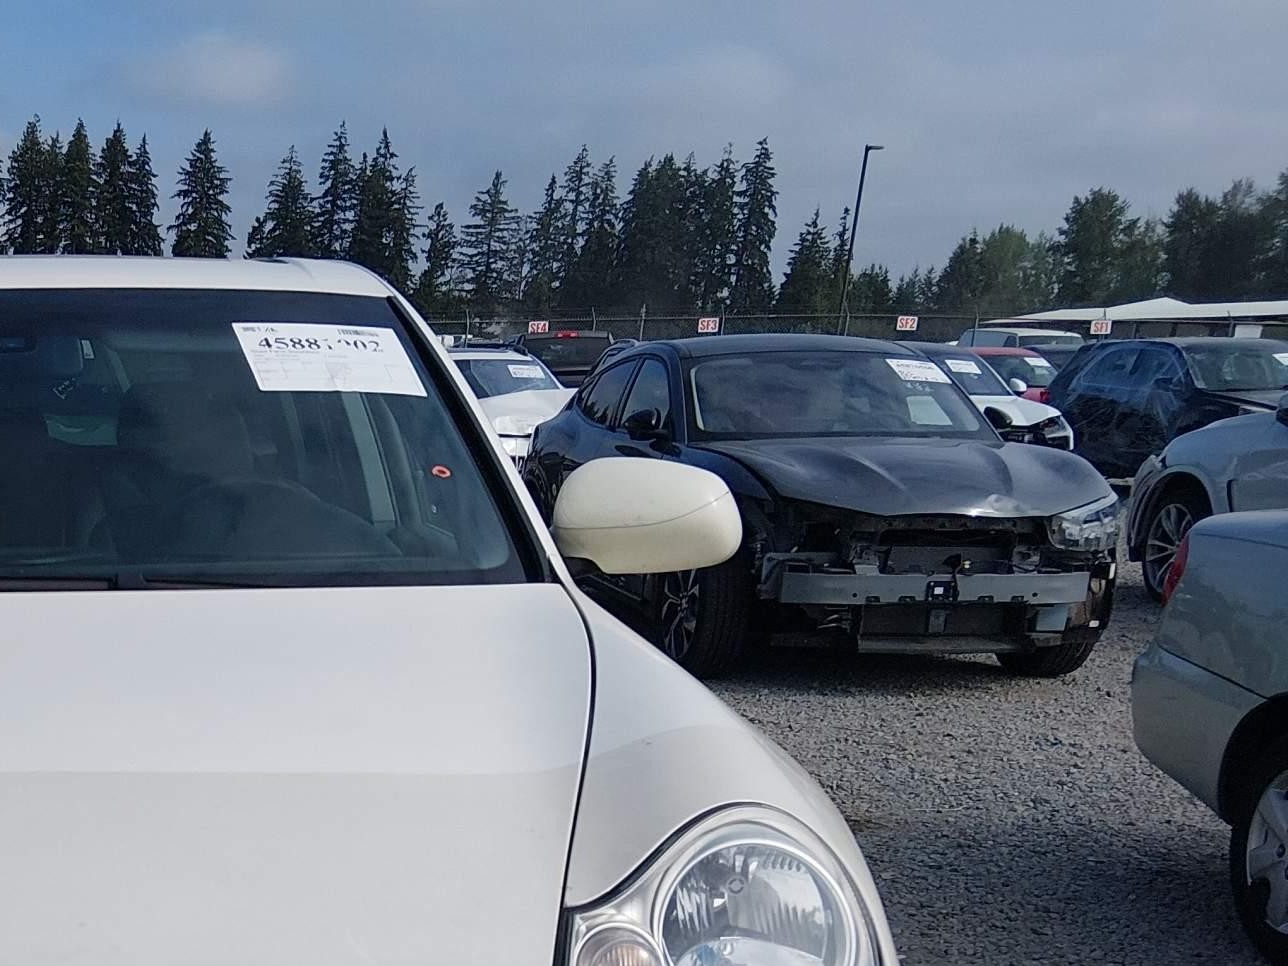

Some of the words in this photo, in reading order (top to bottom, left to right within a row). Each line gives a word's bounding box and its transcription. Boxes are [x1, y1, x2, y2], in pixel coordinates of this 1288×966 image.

[529, 322, 547, 333] SF4
[699, 319, 718, 331] SF3
[898, 317, 916, 329] SF2
[1093, 322, 1109, 333] SF1
